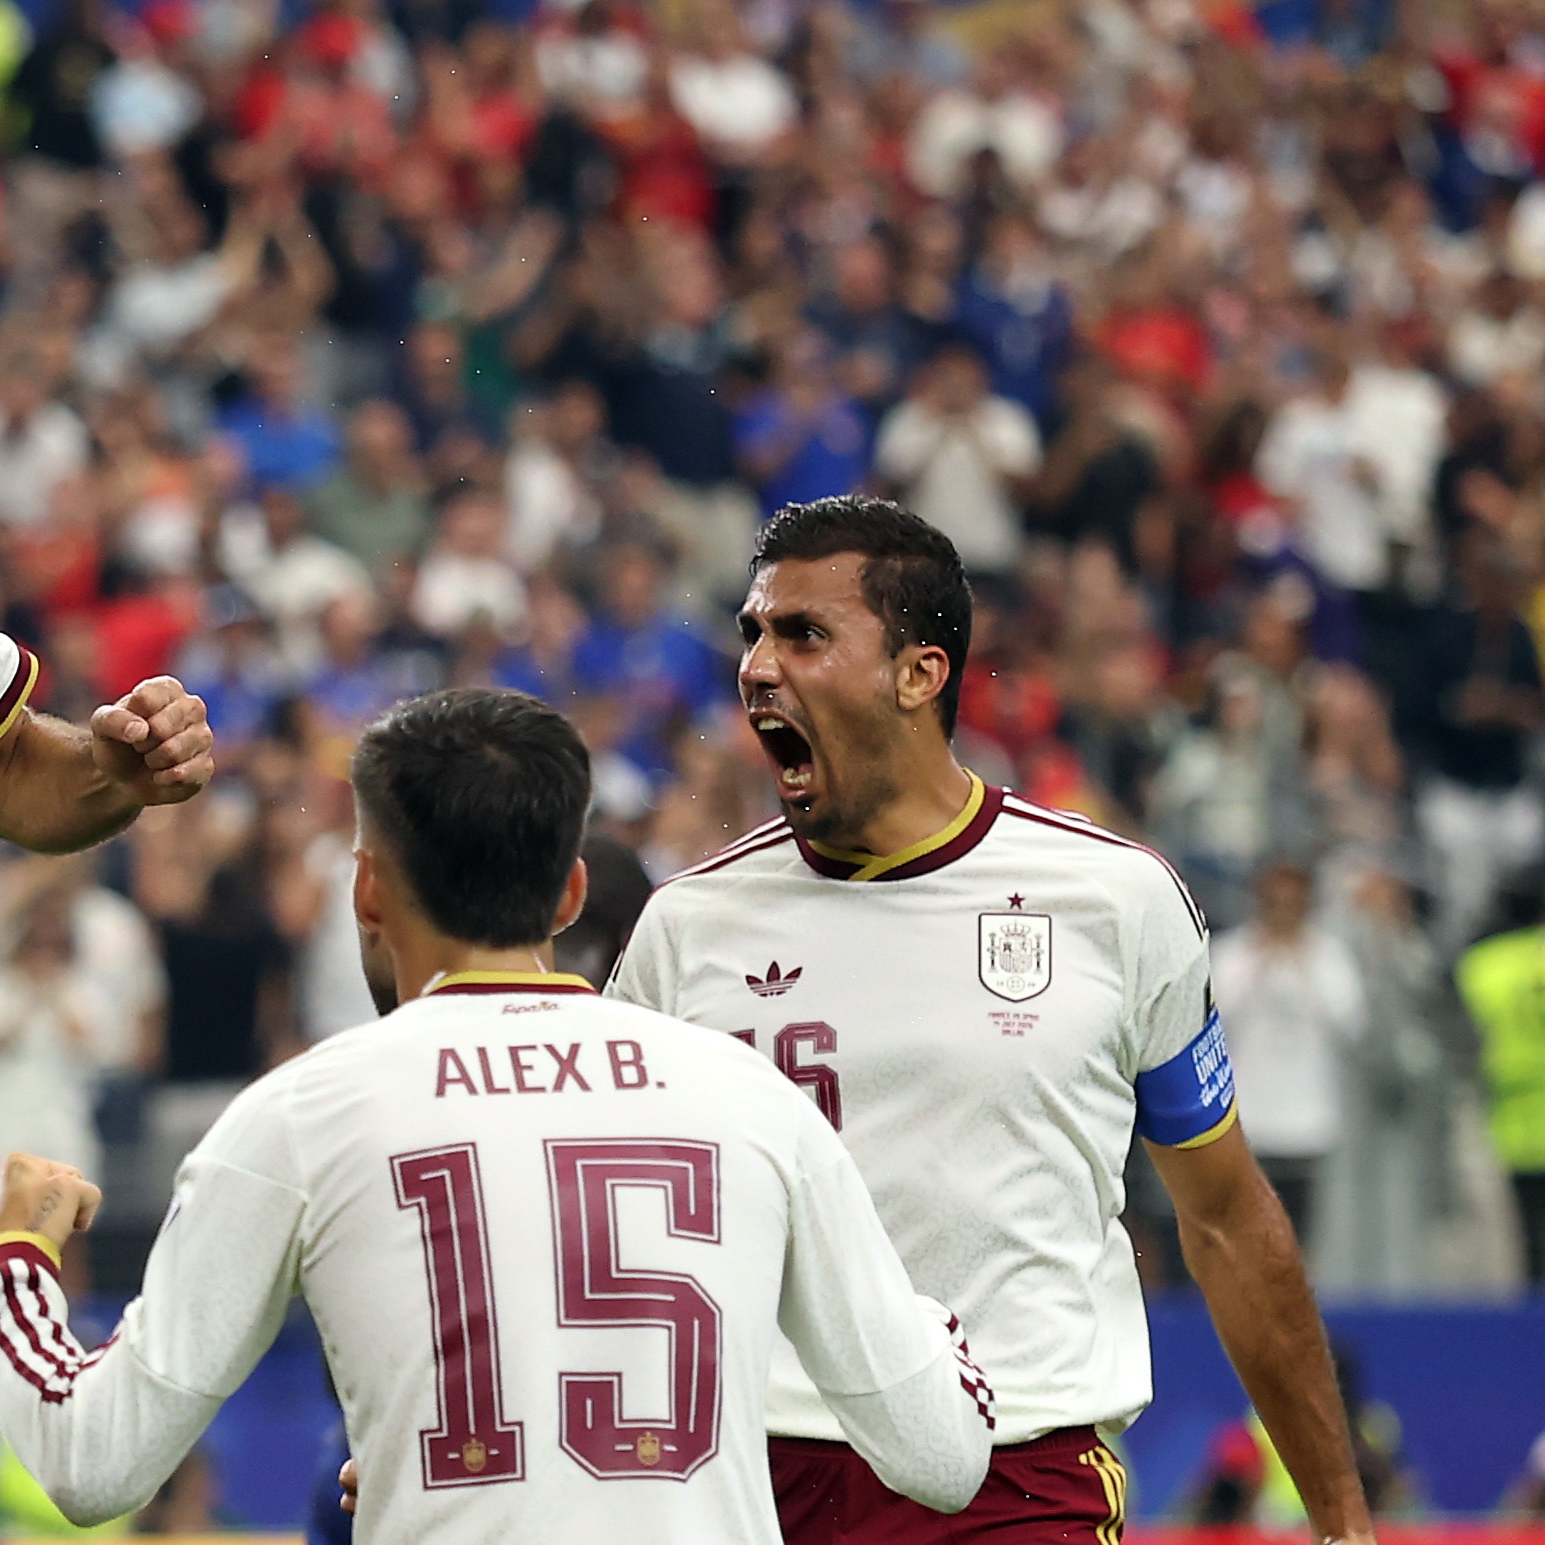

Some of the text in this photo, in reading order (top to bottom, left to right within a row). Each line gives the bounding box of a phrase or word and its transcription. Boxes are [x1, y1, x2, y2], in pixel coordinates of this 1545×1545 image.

[435, 1040, 666, 1098] ALEX B.
[728, 1021, 843, 1133] 6
[389, 1138, 722, 1491] 15
